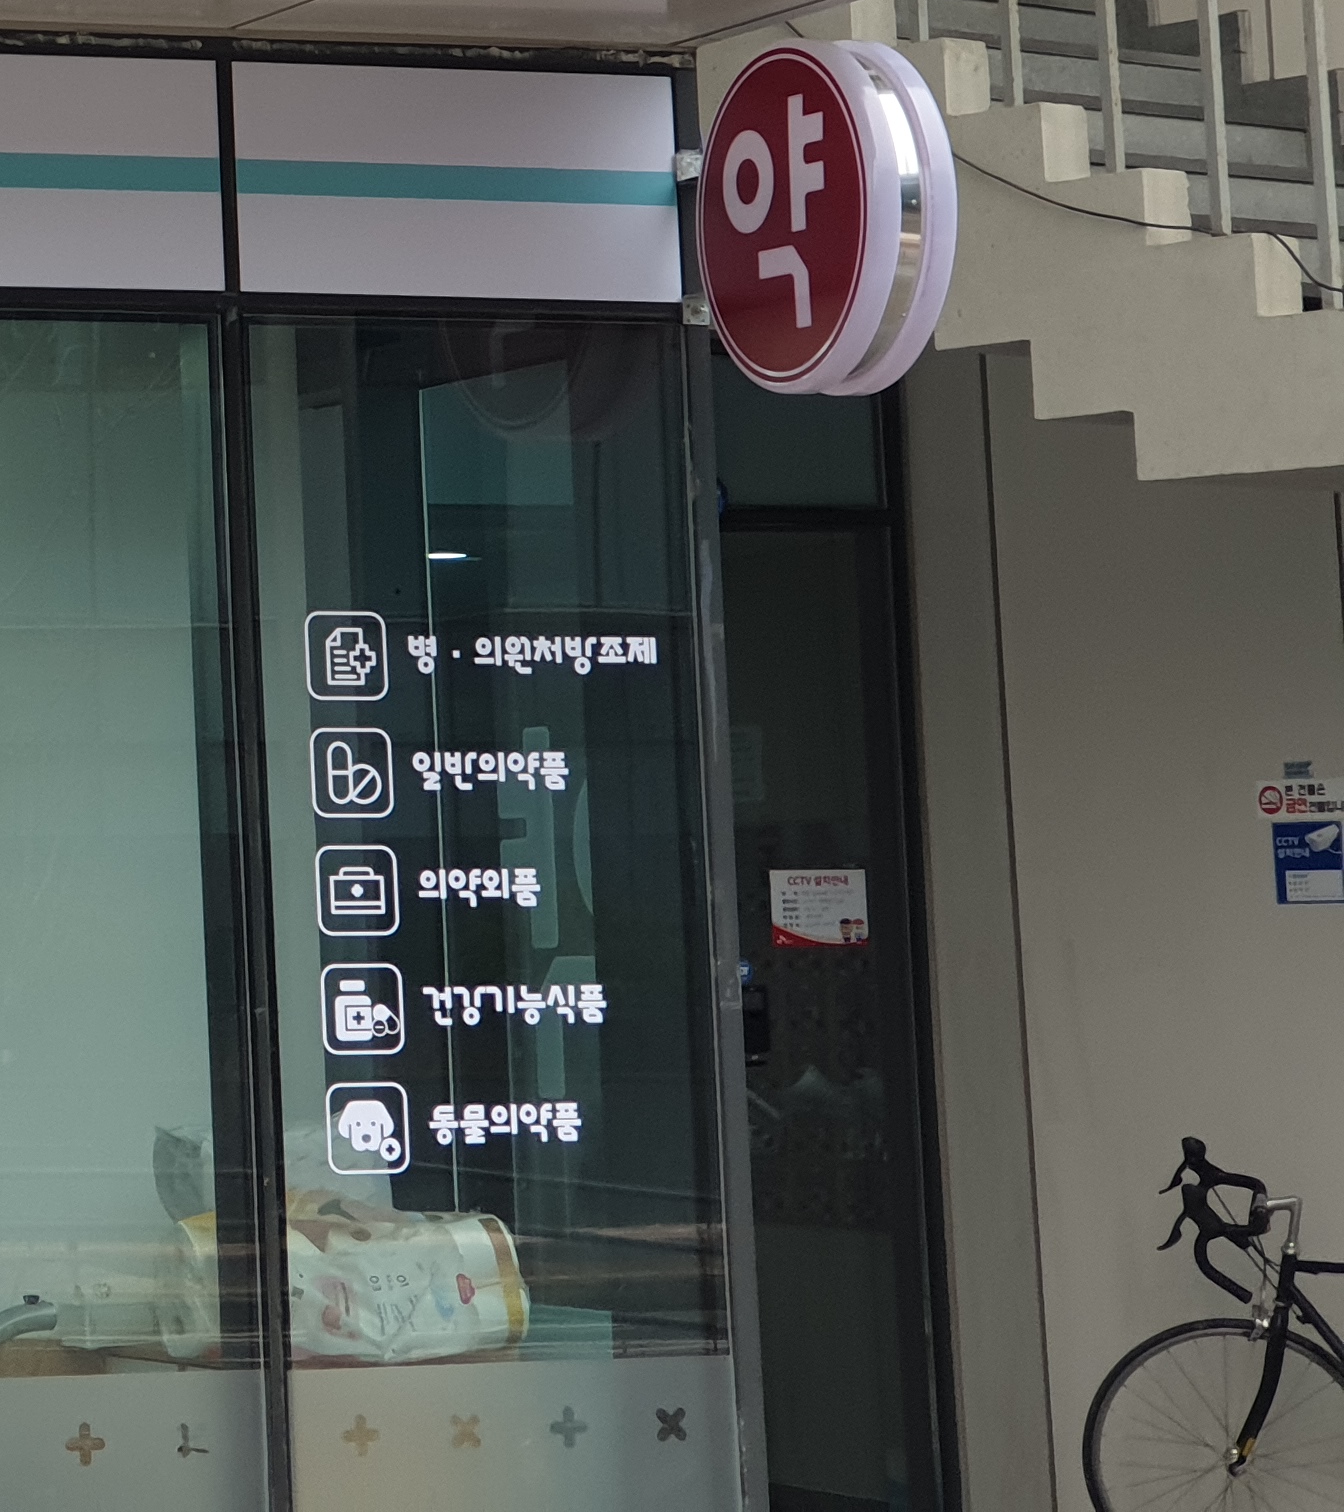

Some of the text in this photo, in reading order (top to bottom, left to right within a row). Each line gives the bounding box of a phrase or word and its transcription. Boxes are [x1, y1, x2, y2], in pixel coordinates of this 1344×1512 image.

[723, 94, 825, 329] 약
[474, 634, 659, 676] 의원처방조제
[411, 750, 569, 791] 일반의약품
[1275, 836, 1300, 847] CCTV
[418, 867, 542, 907] 의약외품
[787, 876, 812, 886] CCTV
[422, 984, 608, 1026] 건강기능식품
[428, 1102, 583, 1146] 동물의약품
